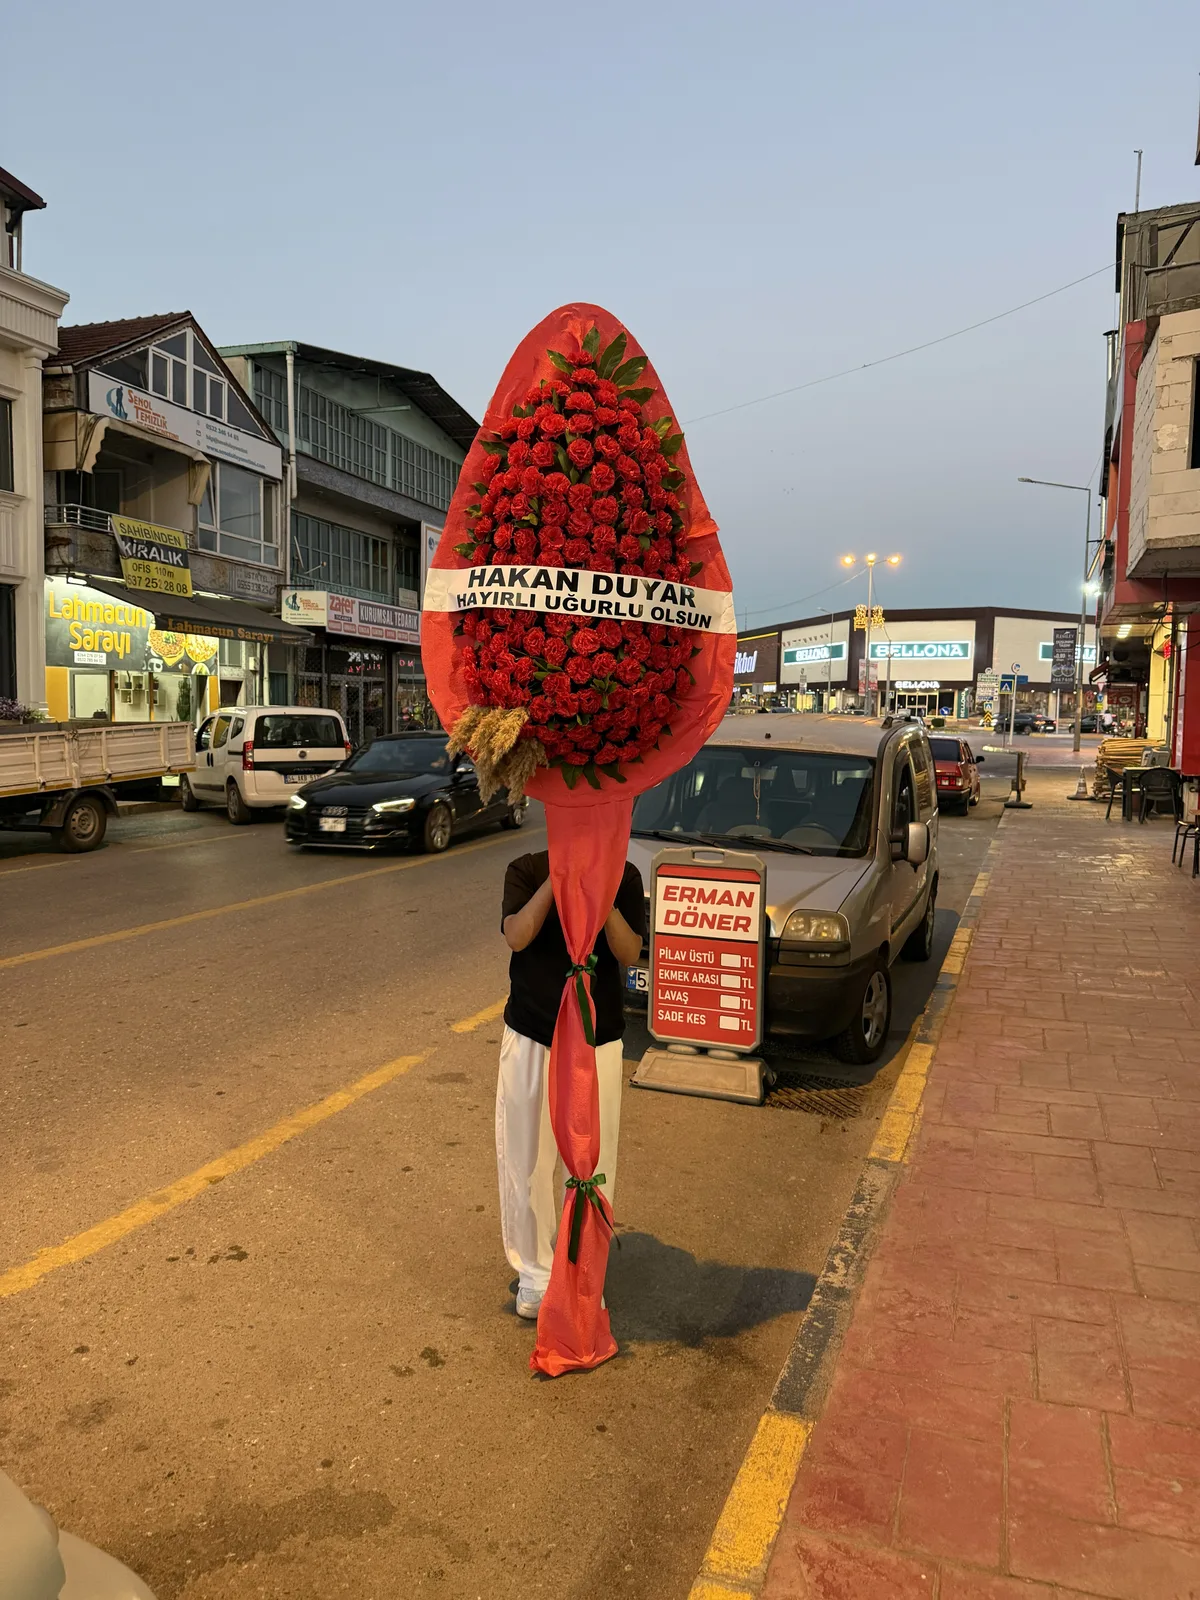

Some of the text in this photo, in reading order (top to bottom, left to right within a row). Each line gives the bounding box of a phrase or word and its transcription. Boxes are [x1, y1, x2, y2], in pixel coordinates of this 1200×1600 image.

[120, 522, 181, 547] SAHİBİNDEN
[122, 539, 184, 566] KİRALIK
[132, 561, 151, 574] OFİS
[164, 580, 174, 592] 28
[176, 583, 188, 594] 08
[468, 568, 696, 608] HAKAN DUYAR
[49, 590, 147, 628] Lahmacun
[330, 595, 356, 614] zafer
[456, 591, 712, 628] HAYIRLI UĞURLU OLSUN
[360, 605, 418, 630] KURUMSAL TEDARİK
[69, 622, 131, 660] Sarayı
[168, 618, 234, 638] Lahmacun
[237, 627, 274, 642] Sarayı
[796, 647, 830, 661] BELLONA
[875, 644, 963, 657] BELLONA
[734, 650, 758, 674] ikbal
[895, 680, 940, 689] BELLONA
[663, 885, 755, 908] ERMAN
[664, 906, 752, 933] DÖNER
[659, 946, 754, 968] PİLAV ÜSTÜ TL
[637, 971, 649, 988] 5
[658, 968, 754, 989] EKMEK ARASI TL
[658, 989, 754, 1010] LAVAŞ TL
[658, 1010, 753, 1031] SADE KES TL
